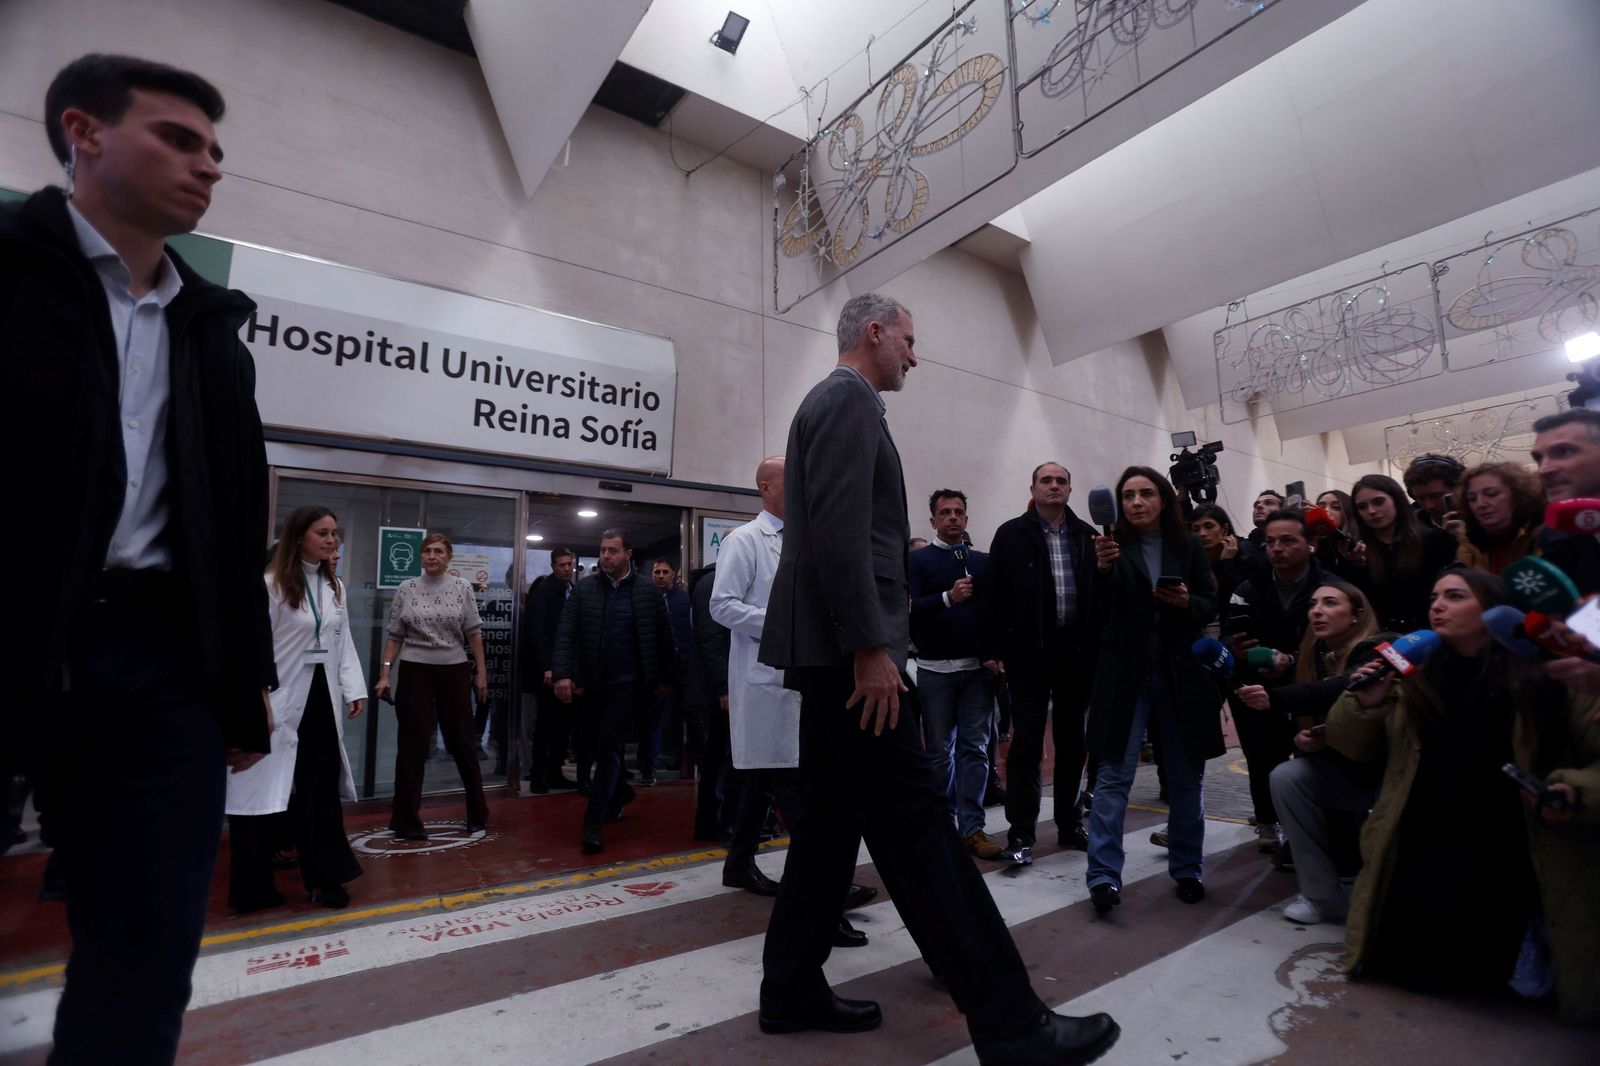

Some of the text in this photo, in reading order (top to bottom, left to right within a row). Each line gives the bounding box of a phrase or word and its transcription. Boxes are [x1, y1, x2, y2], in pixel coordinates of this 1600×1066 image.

[246, 312, 660, 412] Hospital Universitario
[473, 398, 658, 451] Reina Sofía
